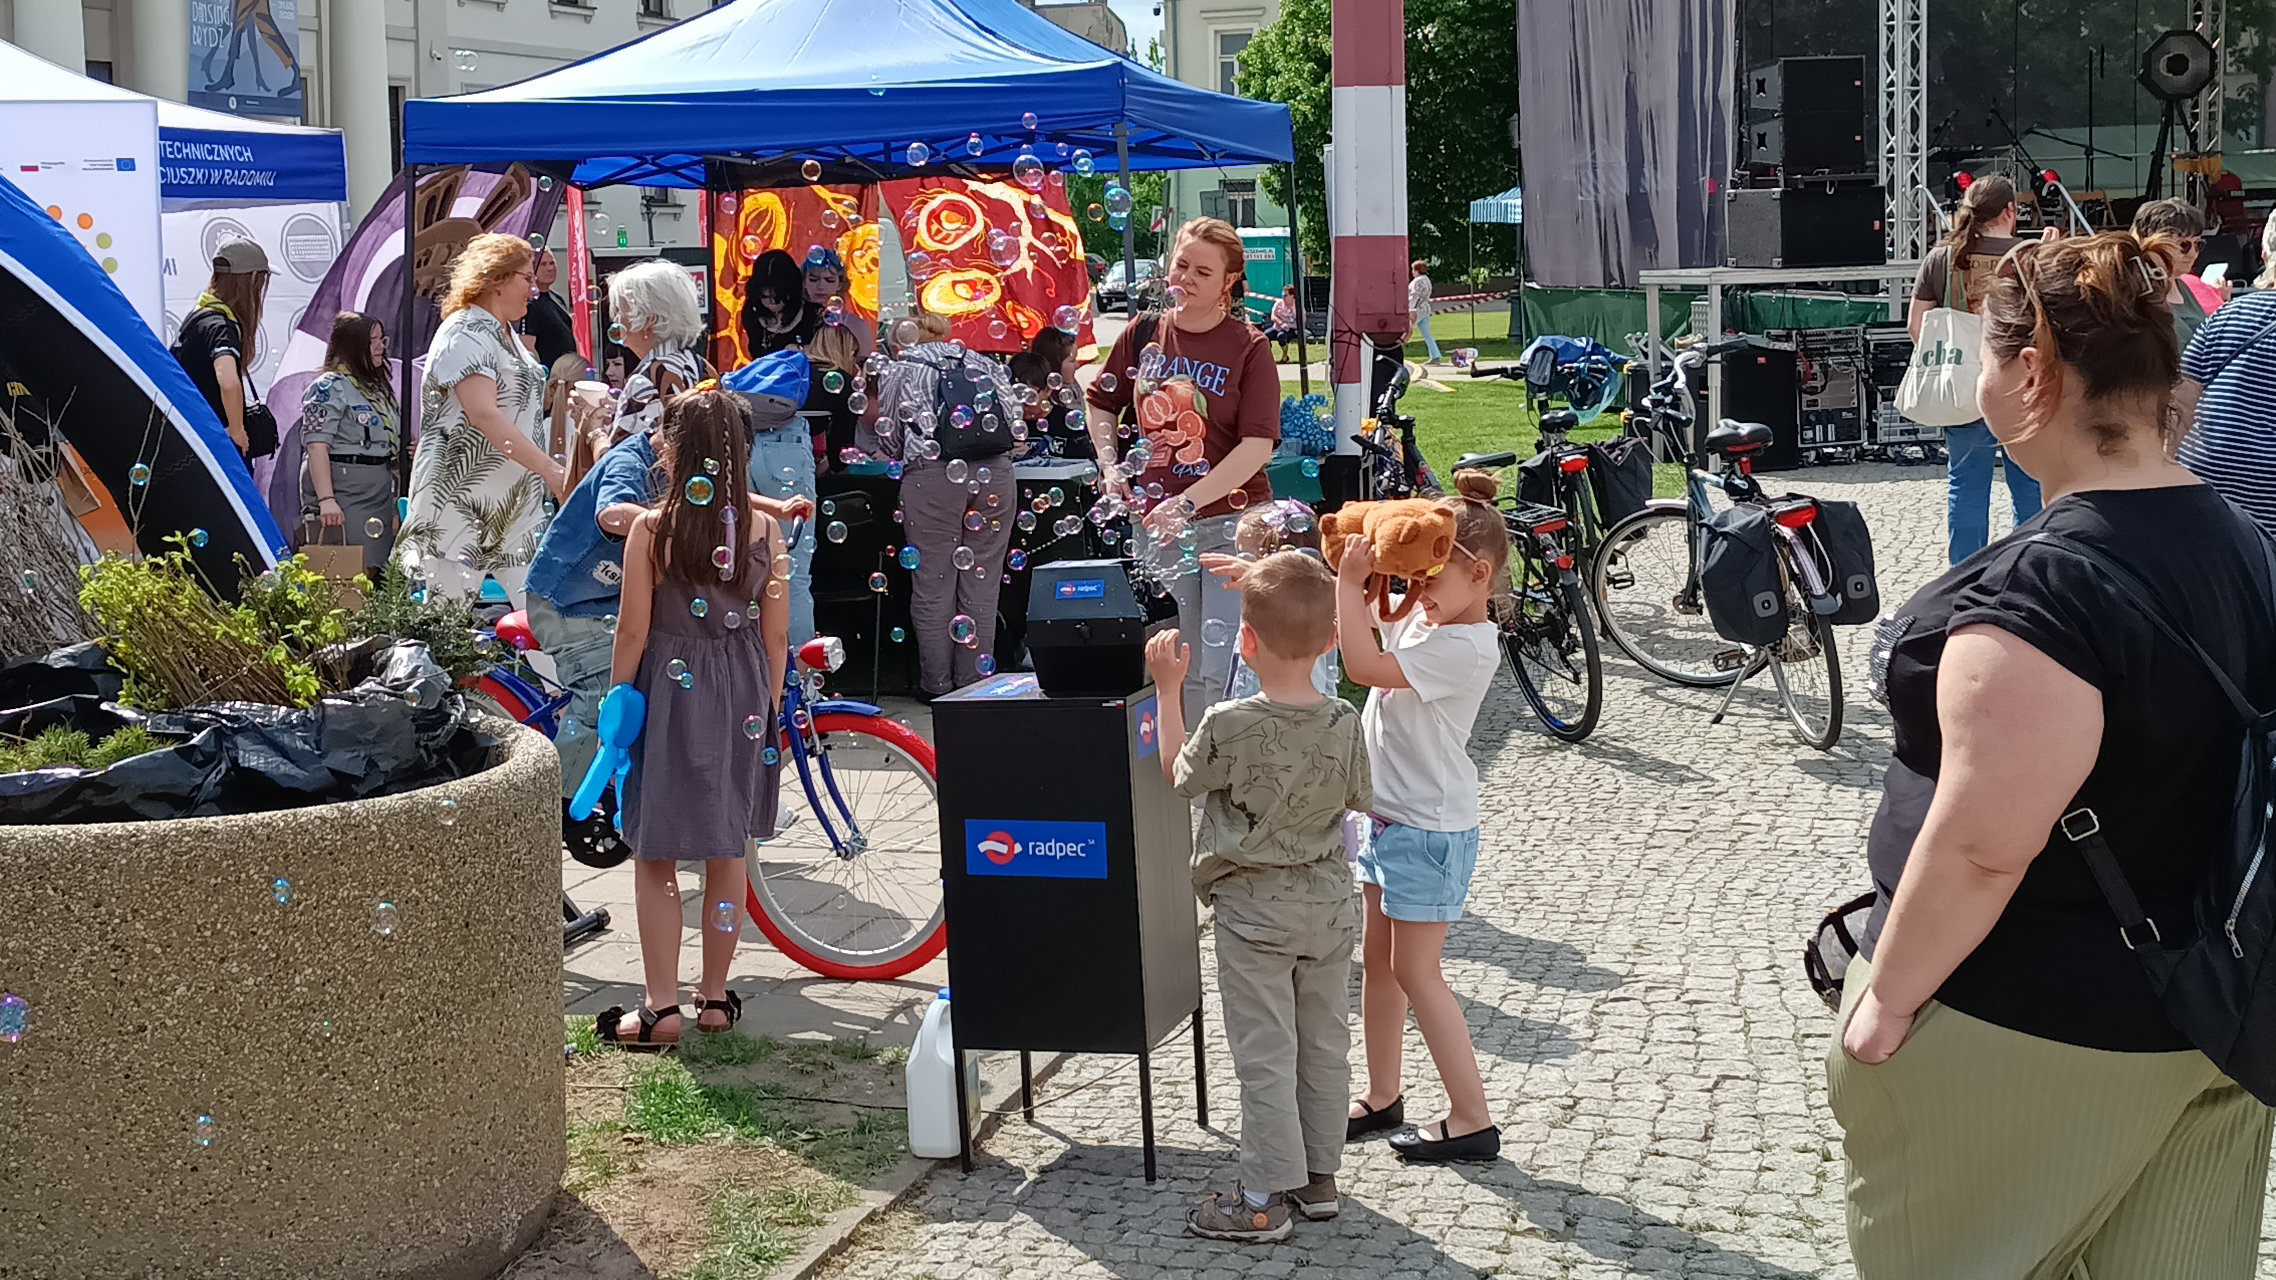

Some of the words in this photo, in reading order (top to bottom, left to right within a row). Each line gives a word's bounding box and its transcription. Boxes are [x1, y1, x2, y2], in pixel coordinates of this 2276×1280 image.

[159, 141, 254, 162] TECHNICZNYCH
[210, 169, 222, 185] W
[222, 169, 277, 187] RADOMIU
[1029, 838, 1086, 860] radpec
